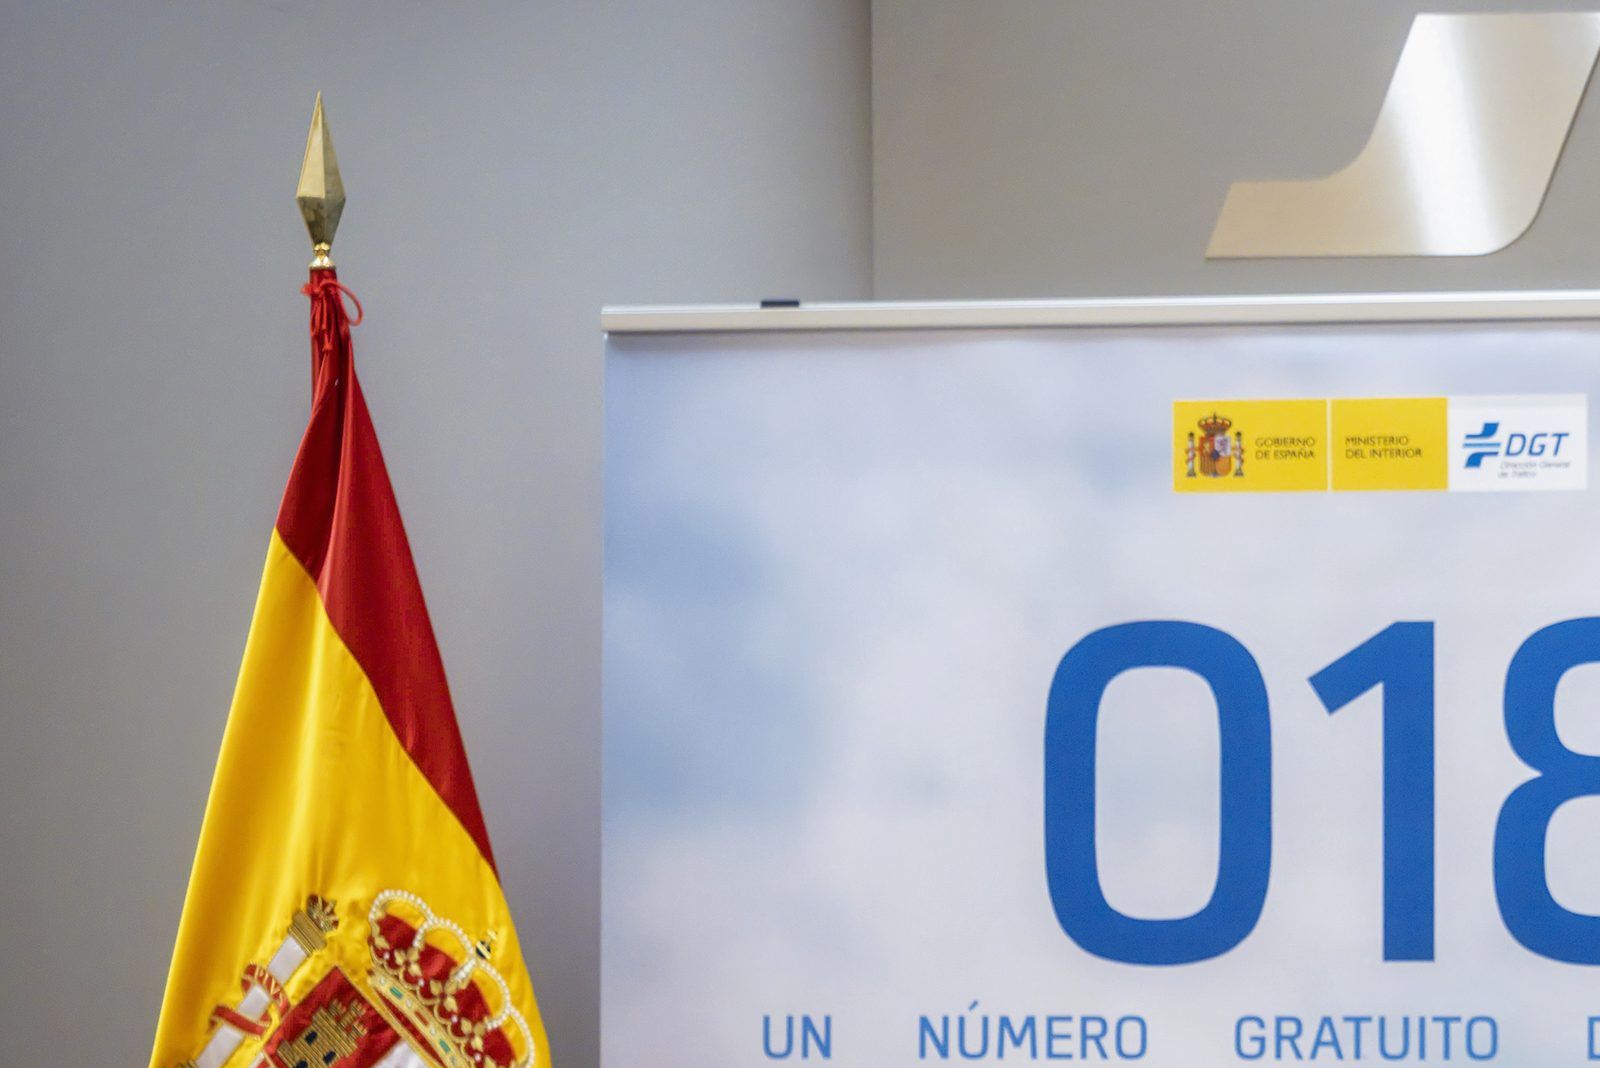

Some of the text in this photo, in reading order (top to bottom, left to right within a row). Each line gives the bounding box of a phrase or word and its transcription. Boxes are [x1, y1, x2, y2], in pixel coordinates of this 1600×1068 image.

[1255, 437, 1315, 447] GOBIERNO
[1345, 435, 1409, 446] MINISTERIO
[1505, 432, 1570, 456] DGT
[1255, 448, 1315, 460] DE ESPAÑA
[1345, 447, 1423, 459] DEL INTERIOR
[762, 1014, 833, 1060] UN
[918, 1000, 1149, 1060] NÚMERO
[1234, 1015, 1499, 1061] GRATUITO
